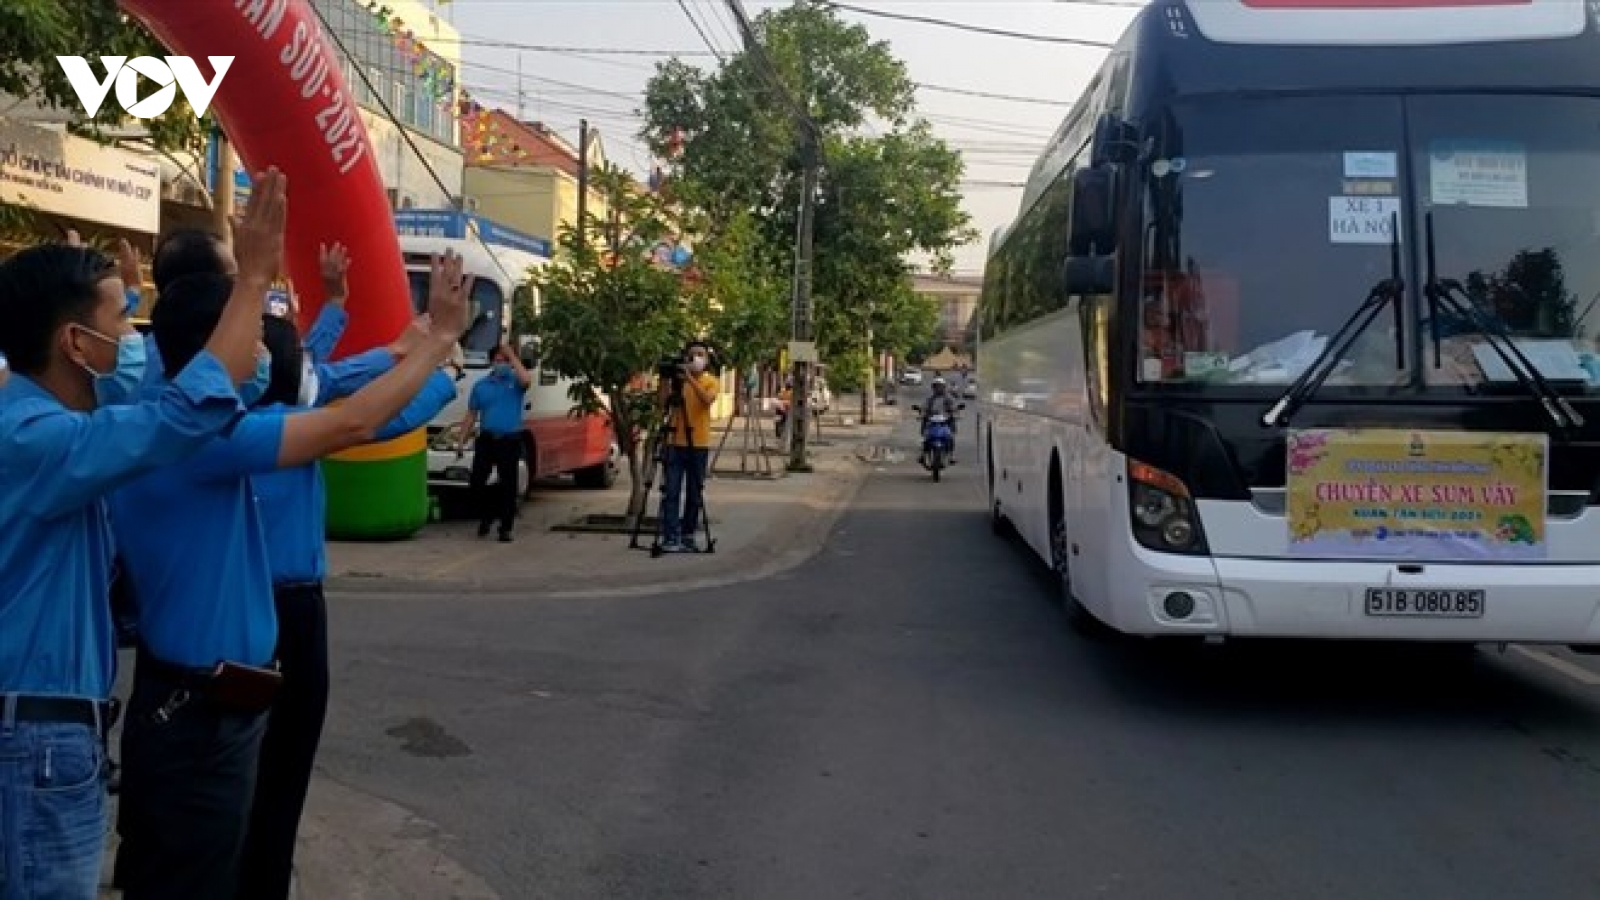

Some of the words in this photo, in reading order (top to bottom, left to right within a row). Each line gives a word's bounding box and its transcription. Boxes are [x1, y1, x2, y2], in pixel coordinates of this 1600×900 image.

[1346, 198, 1370, 212] XE
[1376, 199, 1383, 212] 1
[1333, 214, 1360, 234] HÀ
[1364, 215, 1395, 238] NỘ
[1400, 484, 1423, 503] XE
[1432, 485, 1476, 503] SUM
